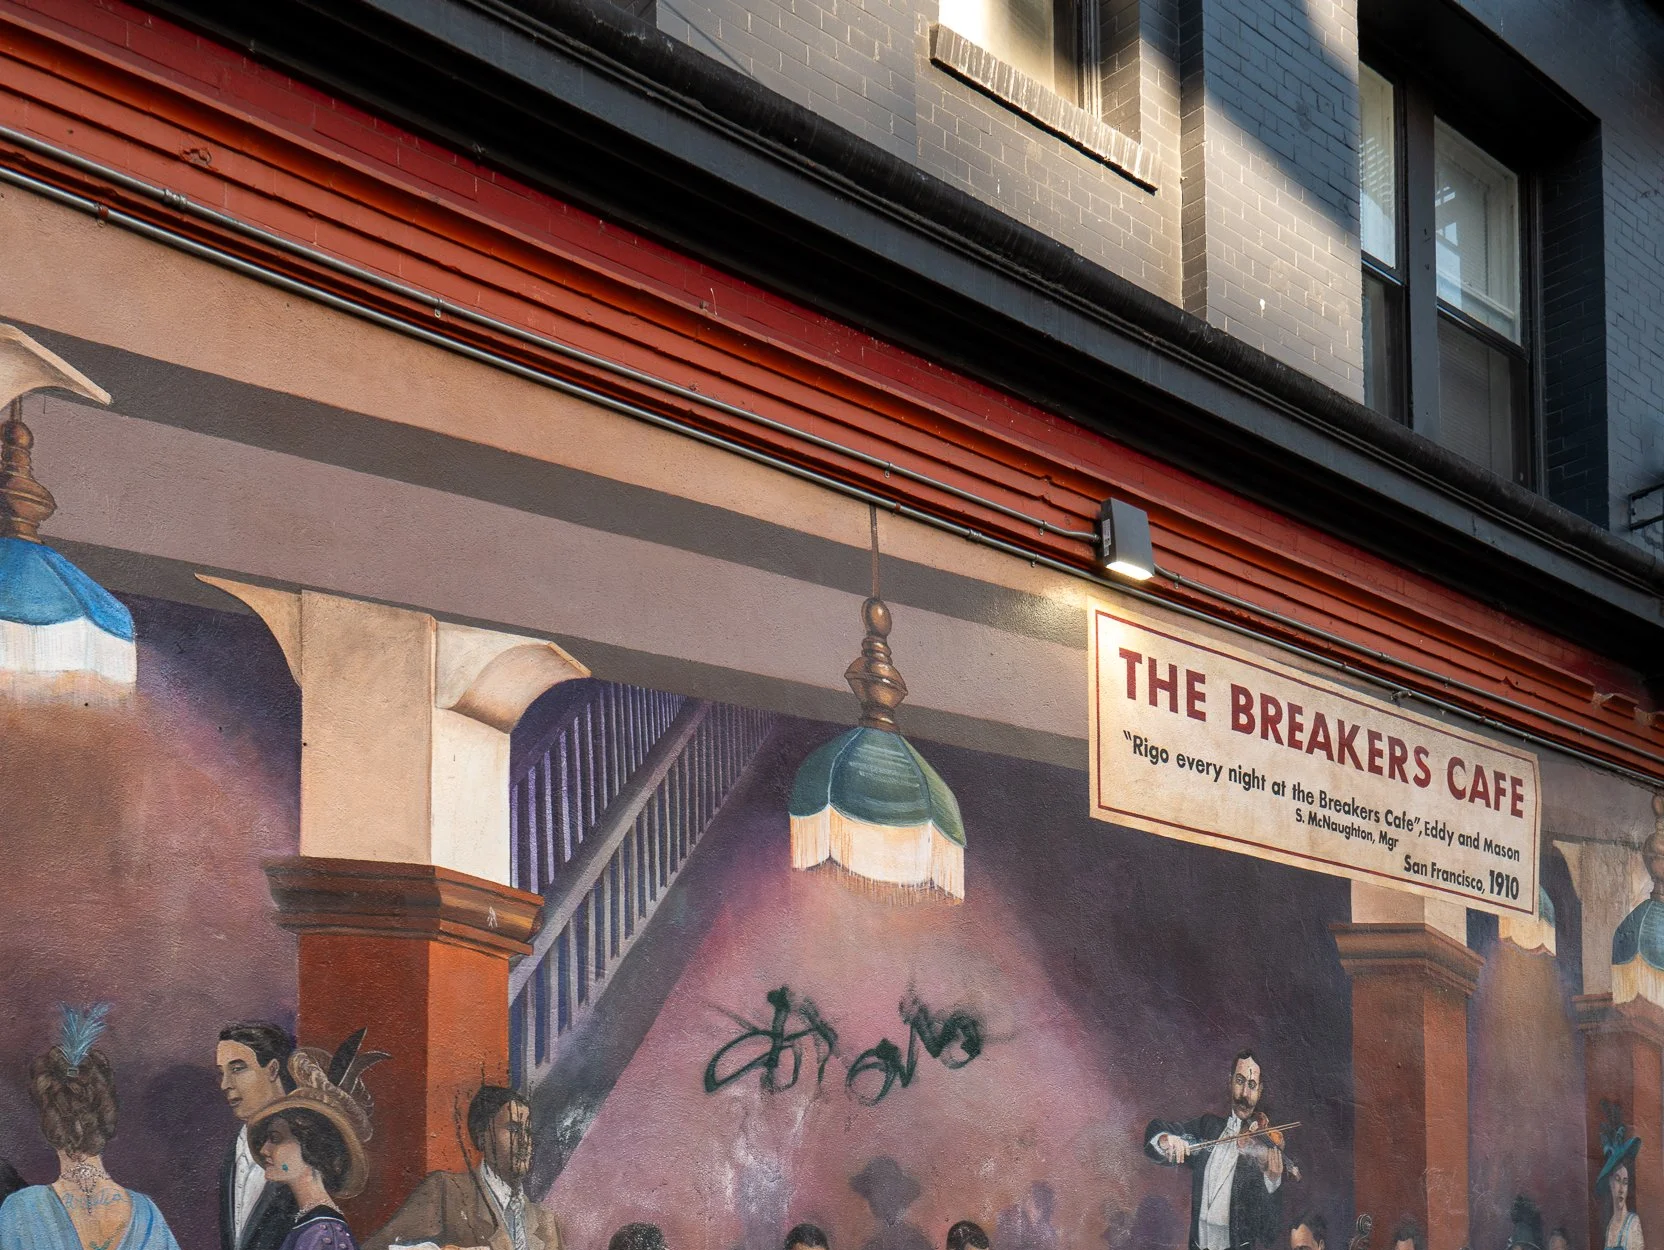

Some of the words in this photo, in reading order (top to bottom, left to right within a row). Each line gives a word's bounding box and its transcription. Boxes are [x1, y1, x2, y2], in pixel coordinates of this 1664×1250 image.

[1119, 647, 1206, 721] THE
[1230, 683, 1431, 789] BREAKERS
[1447, 756, 1524, 818] CAFE
[1176, 753, 1223, 782] every
[1228, 766, 1266, 791] night
[1271, 780, 1287, 796] at
[1292, 783, 1314, 806] the
[1319, 790, 1380, 823] Breakers
[1424, 821, 1453, 847] Eddy
[1458, 831, 1480, 851] and
[1483, 837, 1520, 862] Mason
[1295, 808, 1305, 824] S.
[1307, 813, 1376, 846] McNaughton,
[1378, 830, 1399, 852] Mgr
[1403, 854, 1428, 876] San
[1431, 862, 1486, 895] Francisco,
[1489, 870, 1519, 901] 1910
